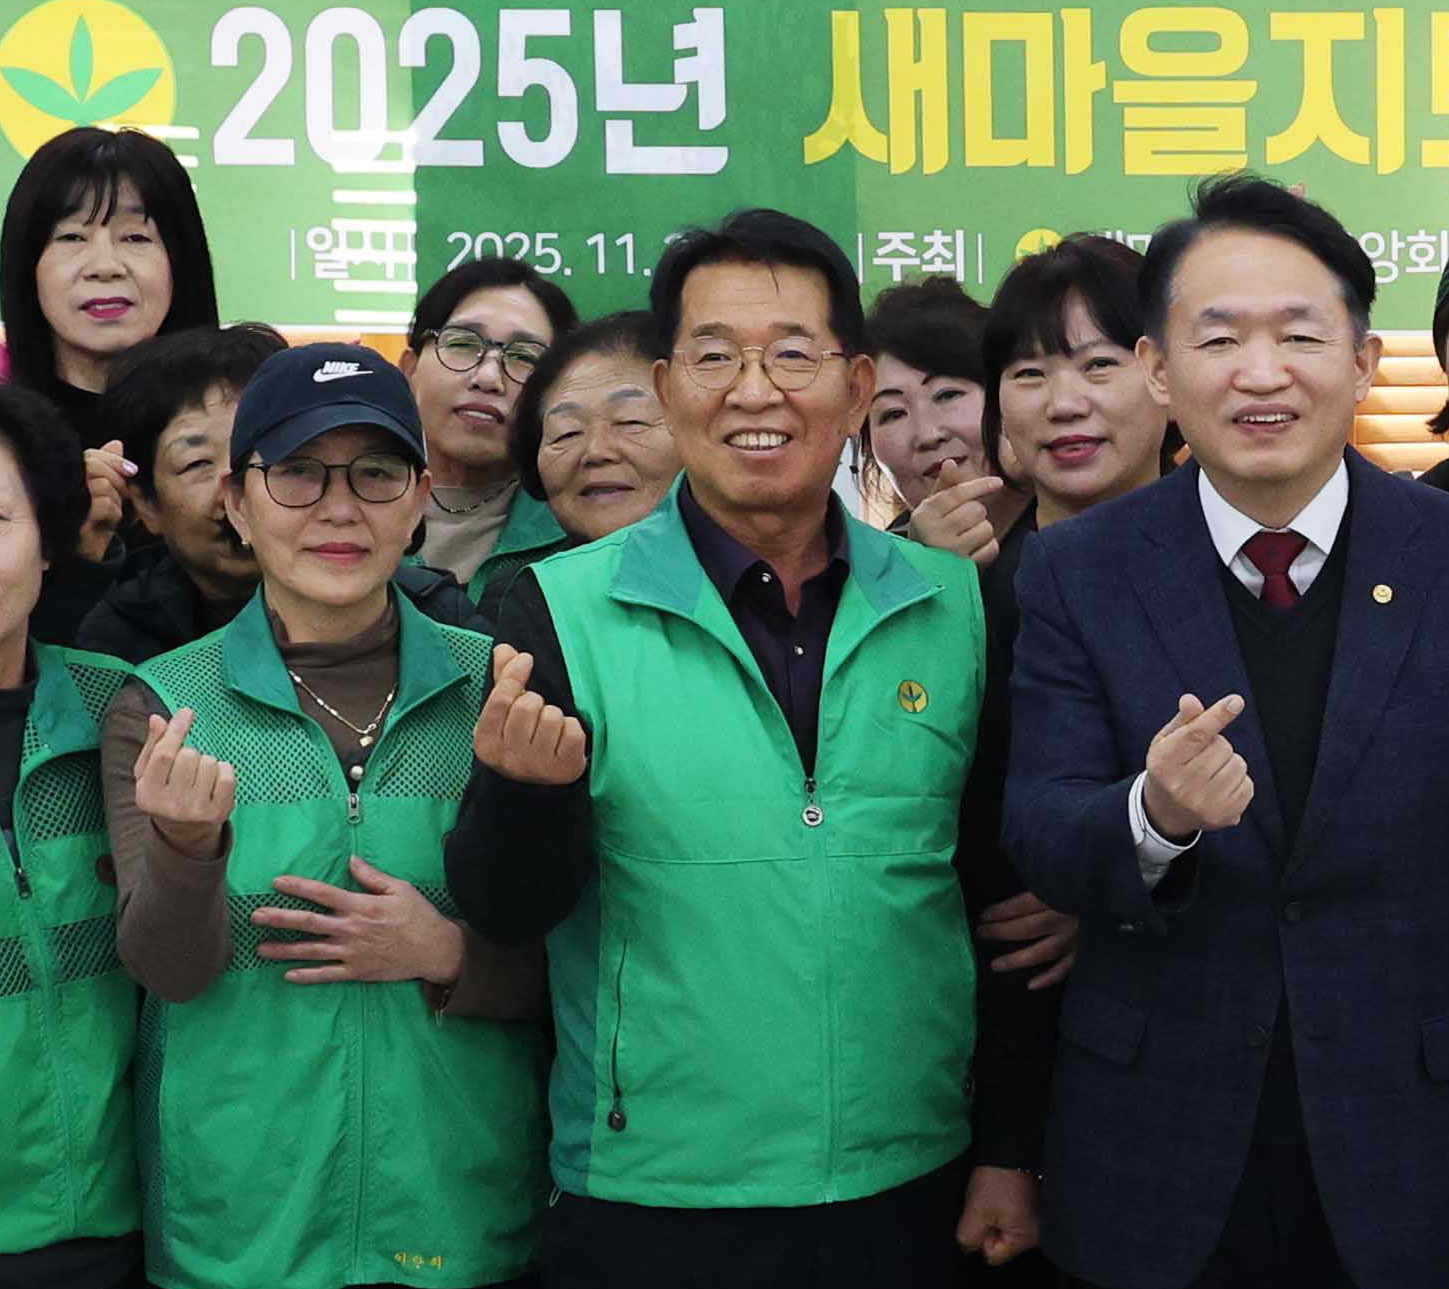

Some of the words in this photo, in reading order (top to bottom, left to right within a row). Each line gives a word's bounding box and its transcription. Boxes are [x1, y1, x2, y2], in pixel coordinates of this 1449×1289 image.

[209, 5, 729, 175] 2025년
[587, 233, 651, 276] 11.
[872, 229, 965, 282] 주최
[322, 361, 360, 374] NIKE
